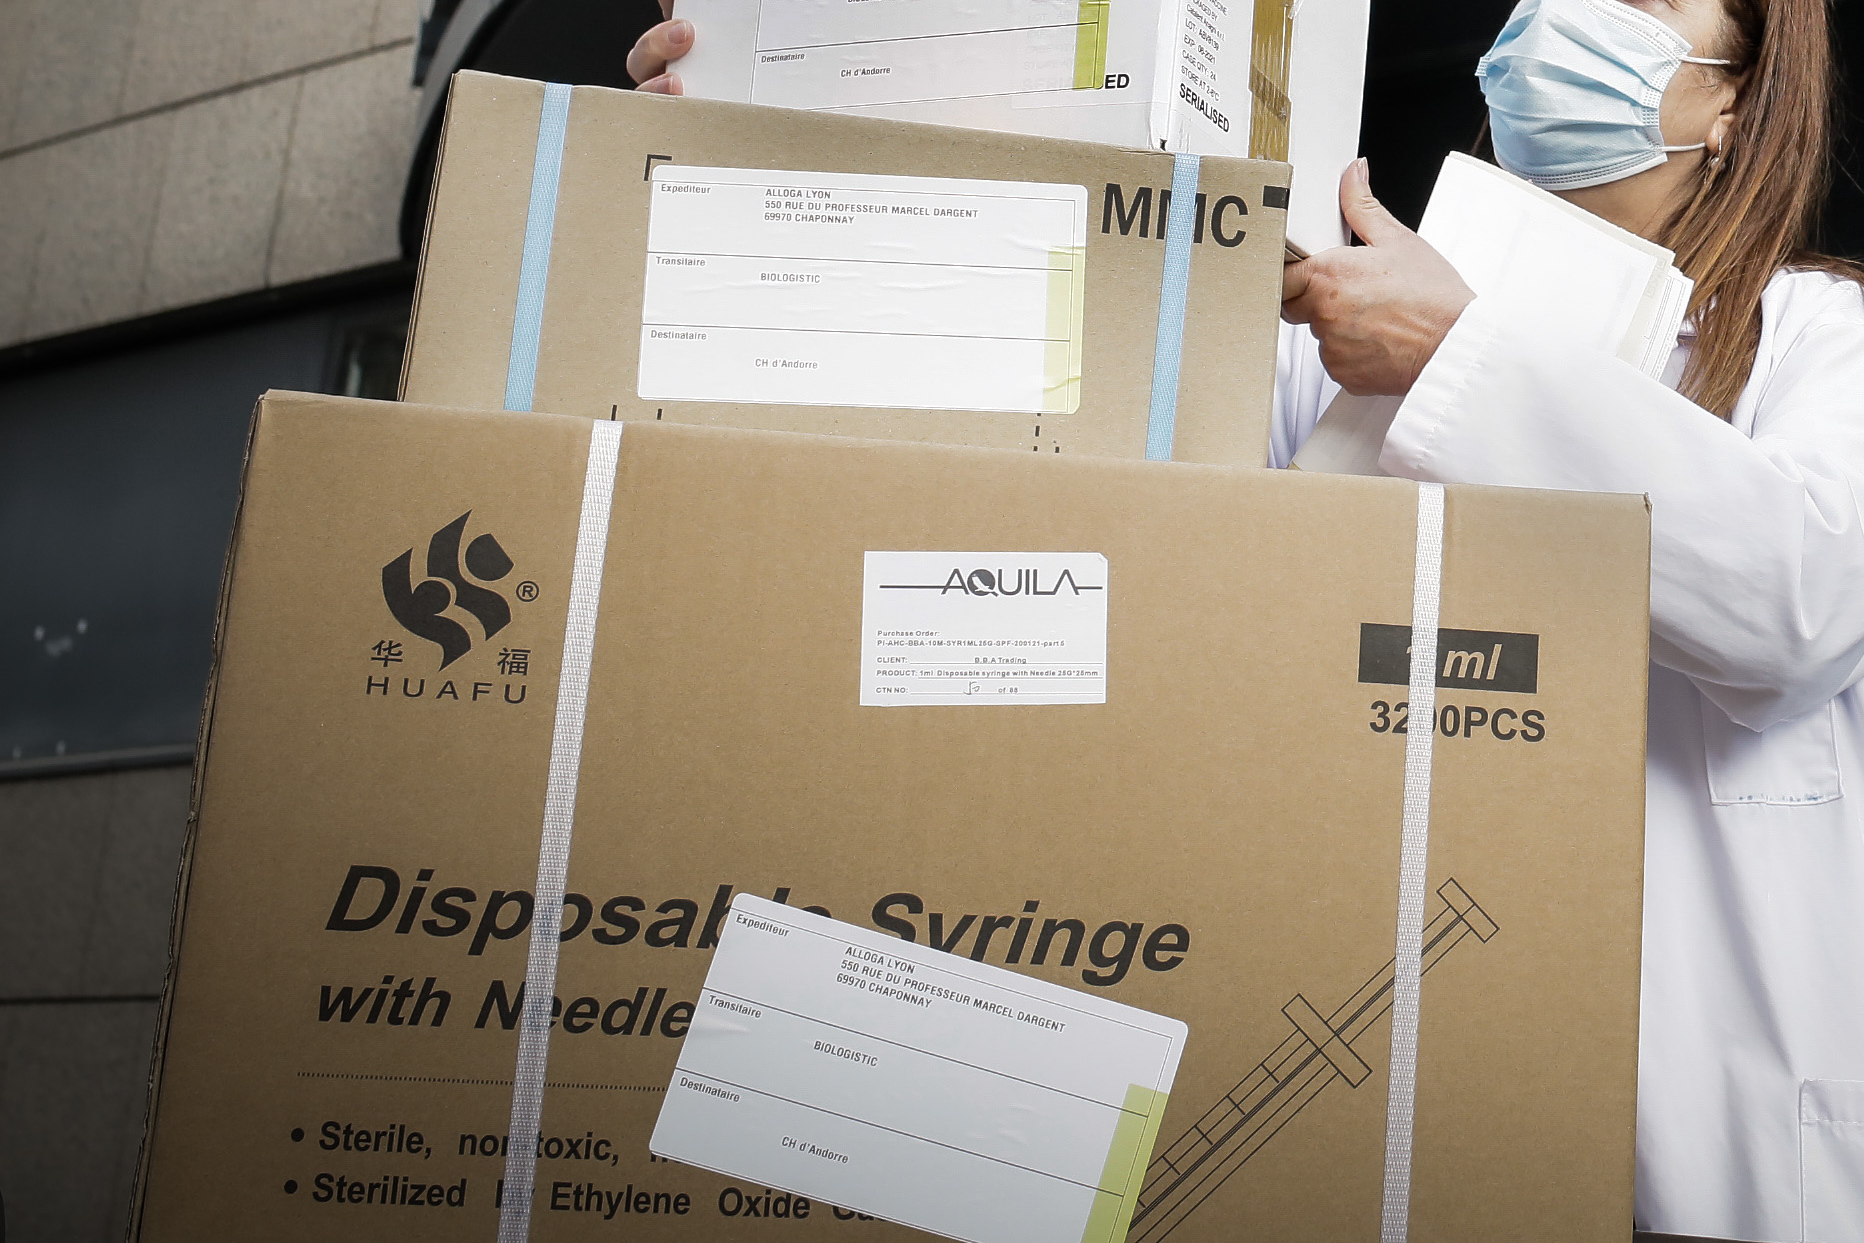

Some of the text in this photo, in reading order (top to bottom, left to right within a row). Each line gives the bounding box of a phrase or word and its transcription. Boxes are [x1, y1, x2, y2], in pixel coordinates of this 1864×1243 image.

[761, 52, 805, 63] Destinataire
[840, 66, 891, 78] CH d'Andorre
[1179, 82, 1230, 133] SERIALISED
[660, 183, 712, 196] Expediteur
[765, 188, 832, 201] ALLOGA LYON
[763, 211, 855, 225] 69970 CHAPONNAY
[764, 199, 979, 219] 550 RUE DU PROFESSEUR MARCEL DARGENT
[656, 255, 706, 268] Transitaire
[760, 272, 821, 284] BIOLOGISTIC
[650, 329, 707, 341] Destinataire
[755, 357, 818, 370] CH d'Andorre
[941, 568, 1081, 597] AQUILA
[876, 656, 908, 664] CLIENT:
[998, 656, 1027, 665] Trading
[876, 669, 918, 677] PRODUCT:
[937, 669, 980, 679] Disposable
[982, 669, 1010, 679] syringe
[1012, 669, 1028, 677] with
[1030, 669, 1056, 677] Needle
[366, 674, 528, 705] HUAFU
[1369, 689, 1546, 743] 320PCS
[736, 913, 790, 938] Expediteur
[844, 945, 916, 975] ALLOGA LYON
[317, 975, 452, 1028] with
[836, 972, 933, 1009] 69970 CHAPONNAY
[840, 959, 1067, 1034] 550 RUE DU PROFESSEUR MARCEL DARGENT
[707, 994, 762, 1019] Transitaire
[813, 1039, 879, 1067] BIOLOGISTIC
[679, 1076, 741, 1103] Destinataire
[318, 1120, 433, 1160] Sterile,
[780, 1135, 850, 1164] CH d'Andorre
[312, 1172, 468, 1209] Sterilized
[549, 1179, 692, 1221] Ethylene
[718, 1186, 812, 1220] Oxide
